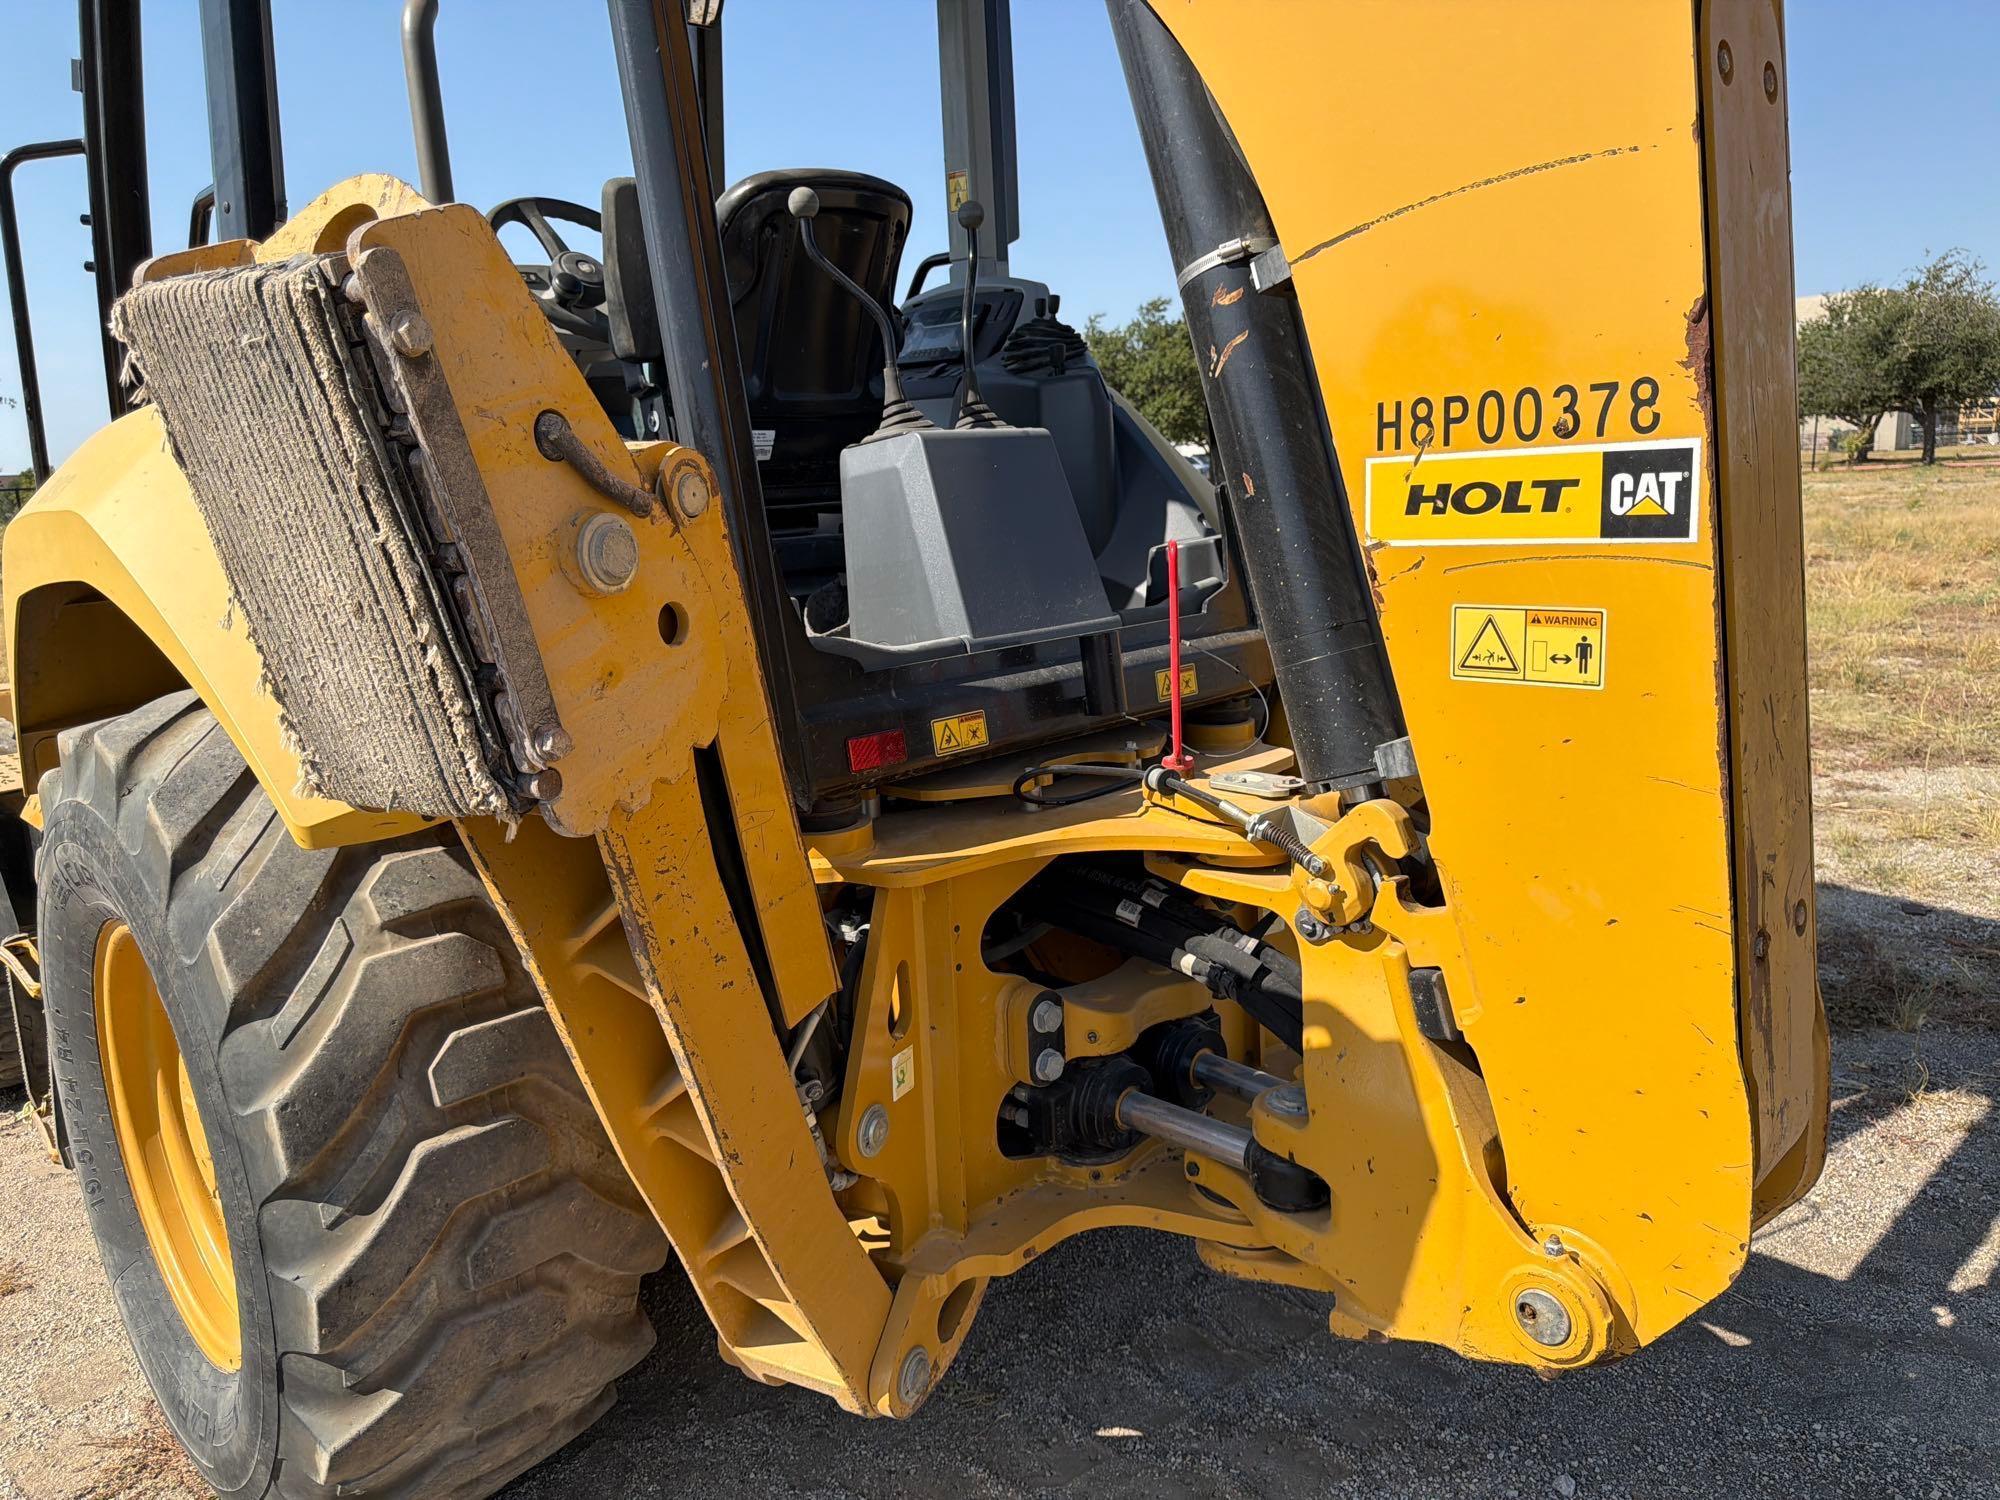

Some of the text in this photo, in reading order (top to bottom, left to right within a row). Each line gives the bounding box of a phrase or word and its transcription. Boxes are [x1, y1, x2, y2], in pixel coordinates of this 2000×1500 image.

[1376, 376, 1662, 452] H8P00378
[1404, 471, 1683, 516] HOLT CAT
[1544, 615, 1598, 627] WARNING
